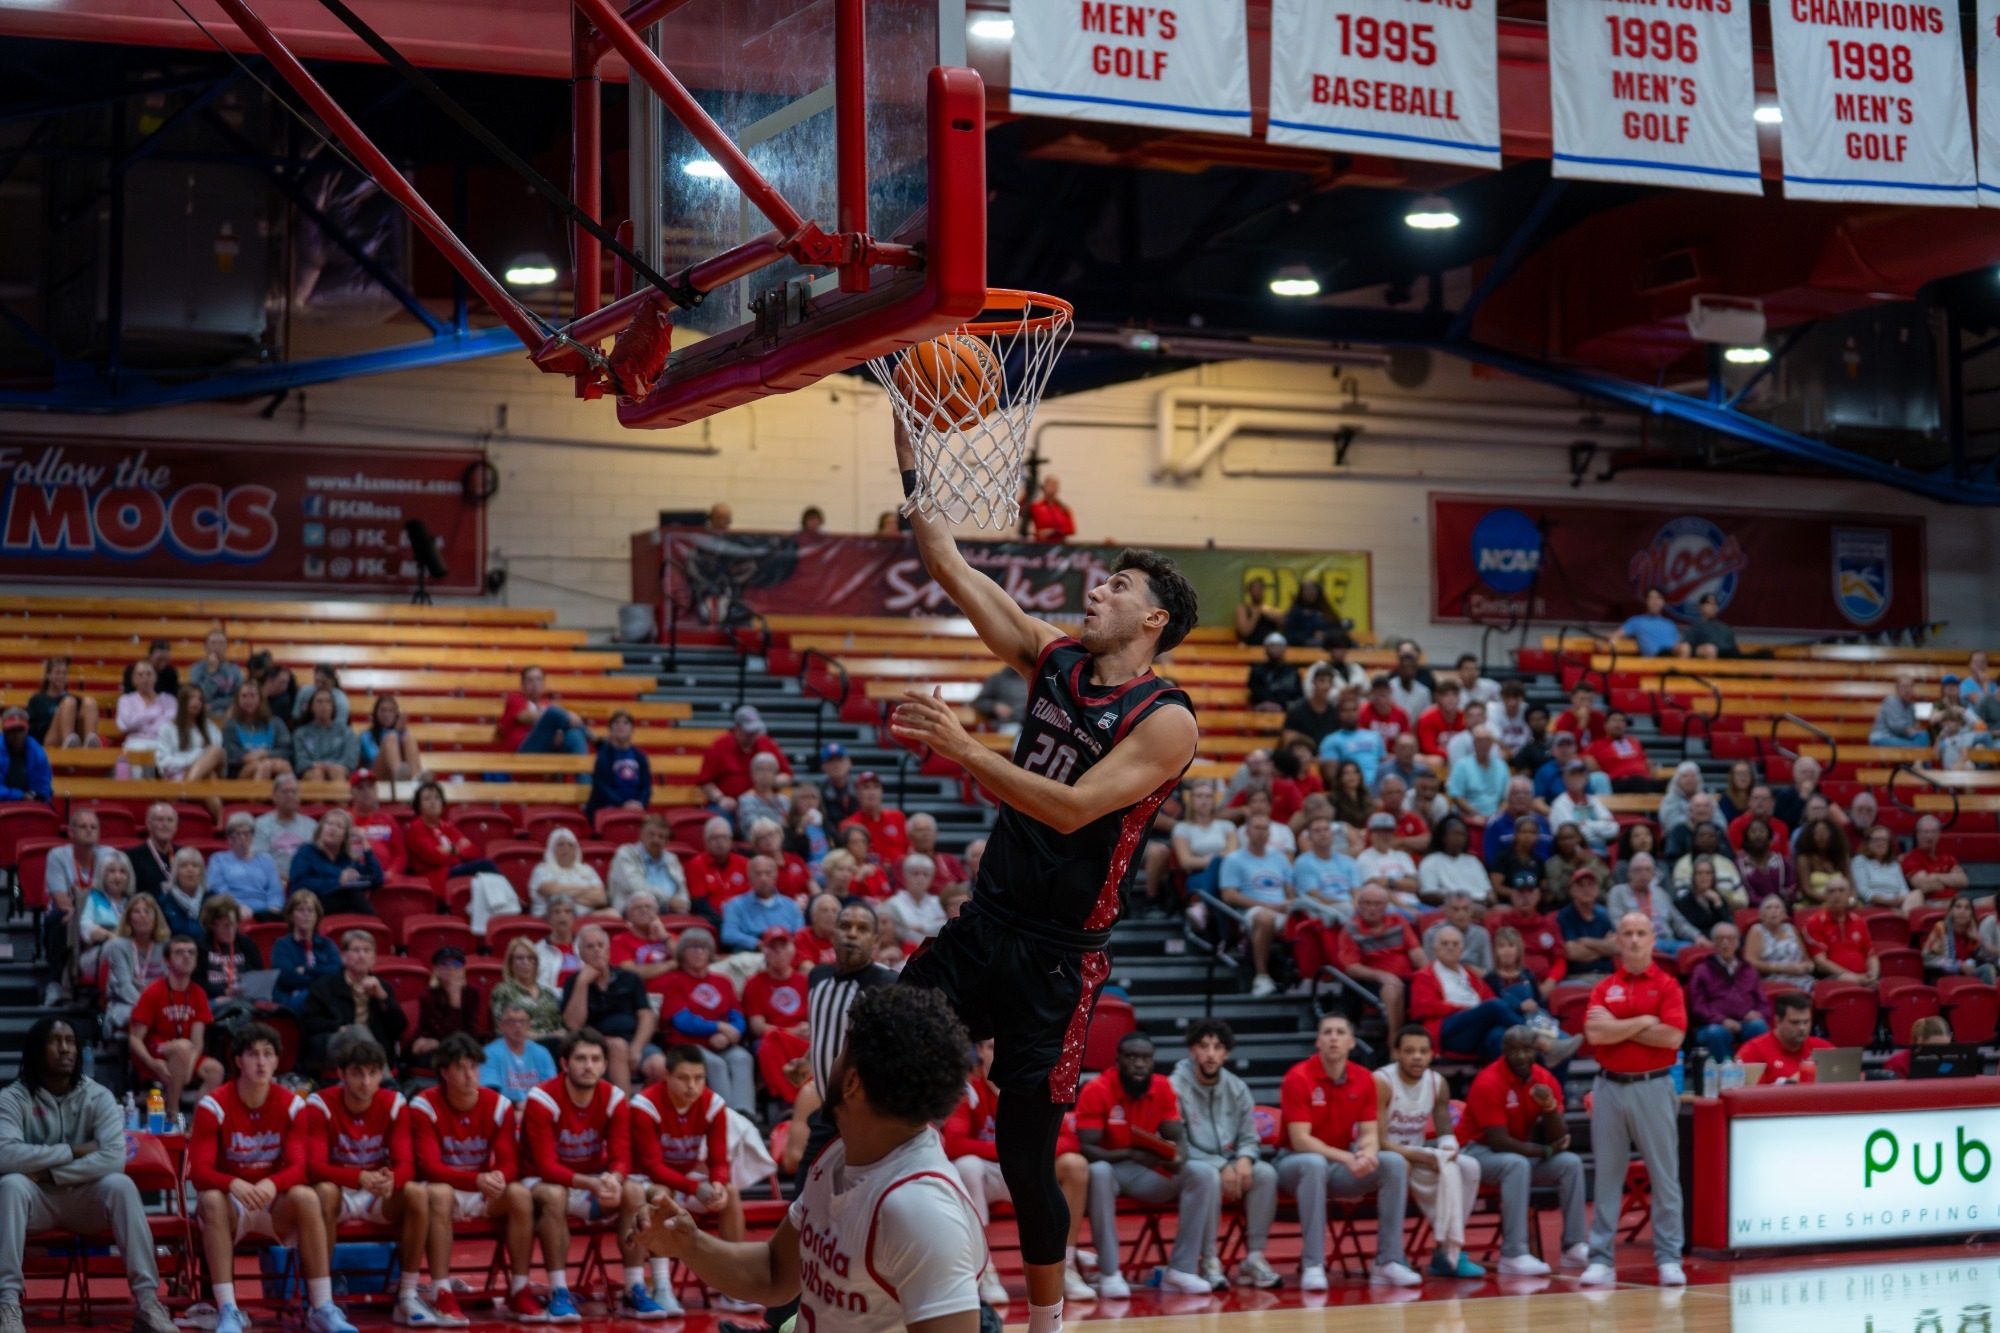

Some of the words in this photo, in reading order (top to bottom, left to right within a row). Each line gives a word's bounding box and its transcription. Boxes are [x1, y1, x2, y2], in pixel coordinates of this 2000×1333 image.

[1081, 0, 1177, 41] MEN'S
[1790, 0, 1943, 35] CHAMPIONS
[1335, 14, 1437, 66] 1995
[1605, 15, 1698, 64] 1996
[1092, 44, 1169, 82] GOLF
[1827, 39, 1915, 84] 1998
[1312, 74, 1461, 121] BASEBALL
[1612, 70, 1697, 107] MEN'S
[1622, 111, 1691, 145] GOLF
[1834, 94, 1915, 126] MEN'S
[1845, 132, 1909, 163] GOLF
[0, 446, 106, 487] Follow
[111, 450, 171, 489] the
[2, 482, 279, 561] MOCS
[1478, 546, 1541, 573] NCAA
[1031, 696, 1073, 733] FLORIDA
[1023, 732, 1078, 785] 20
[1865, 1125, 1992, 1188] Pub
[1737, 1214, 1826, 1233] WHERE
[1846, 1205, 1978, 1227] SHOPPING
